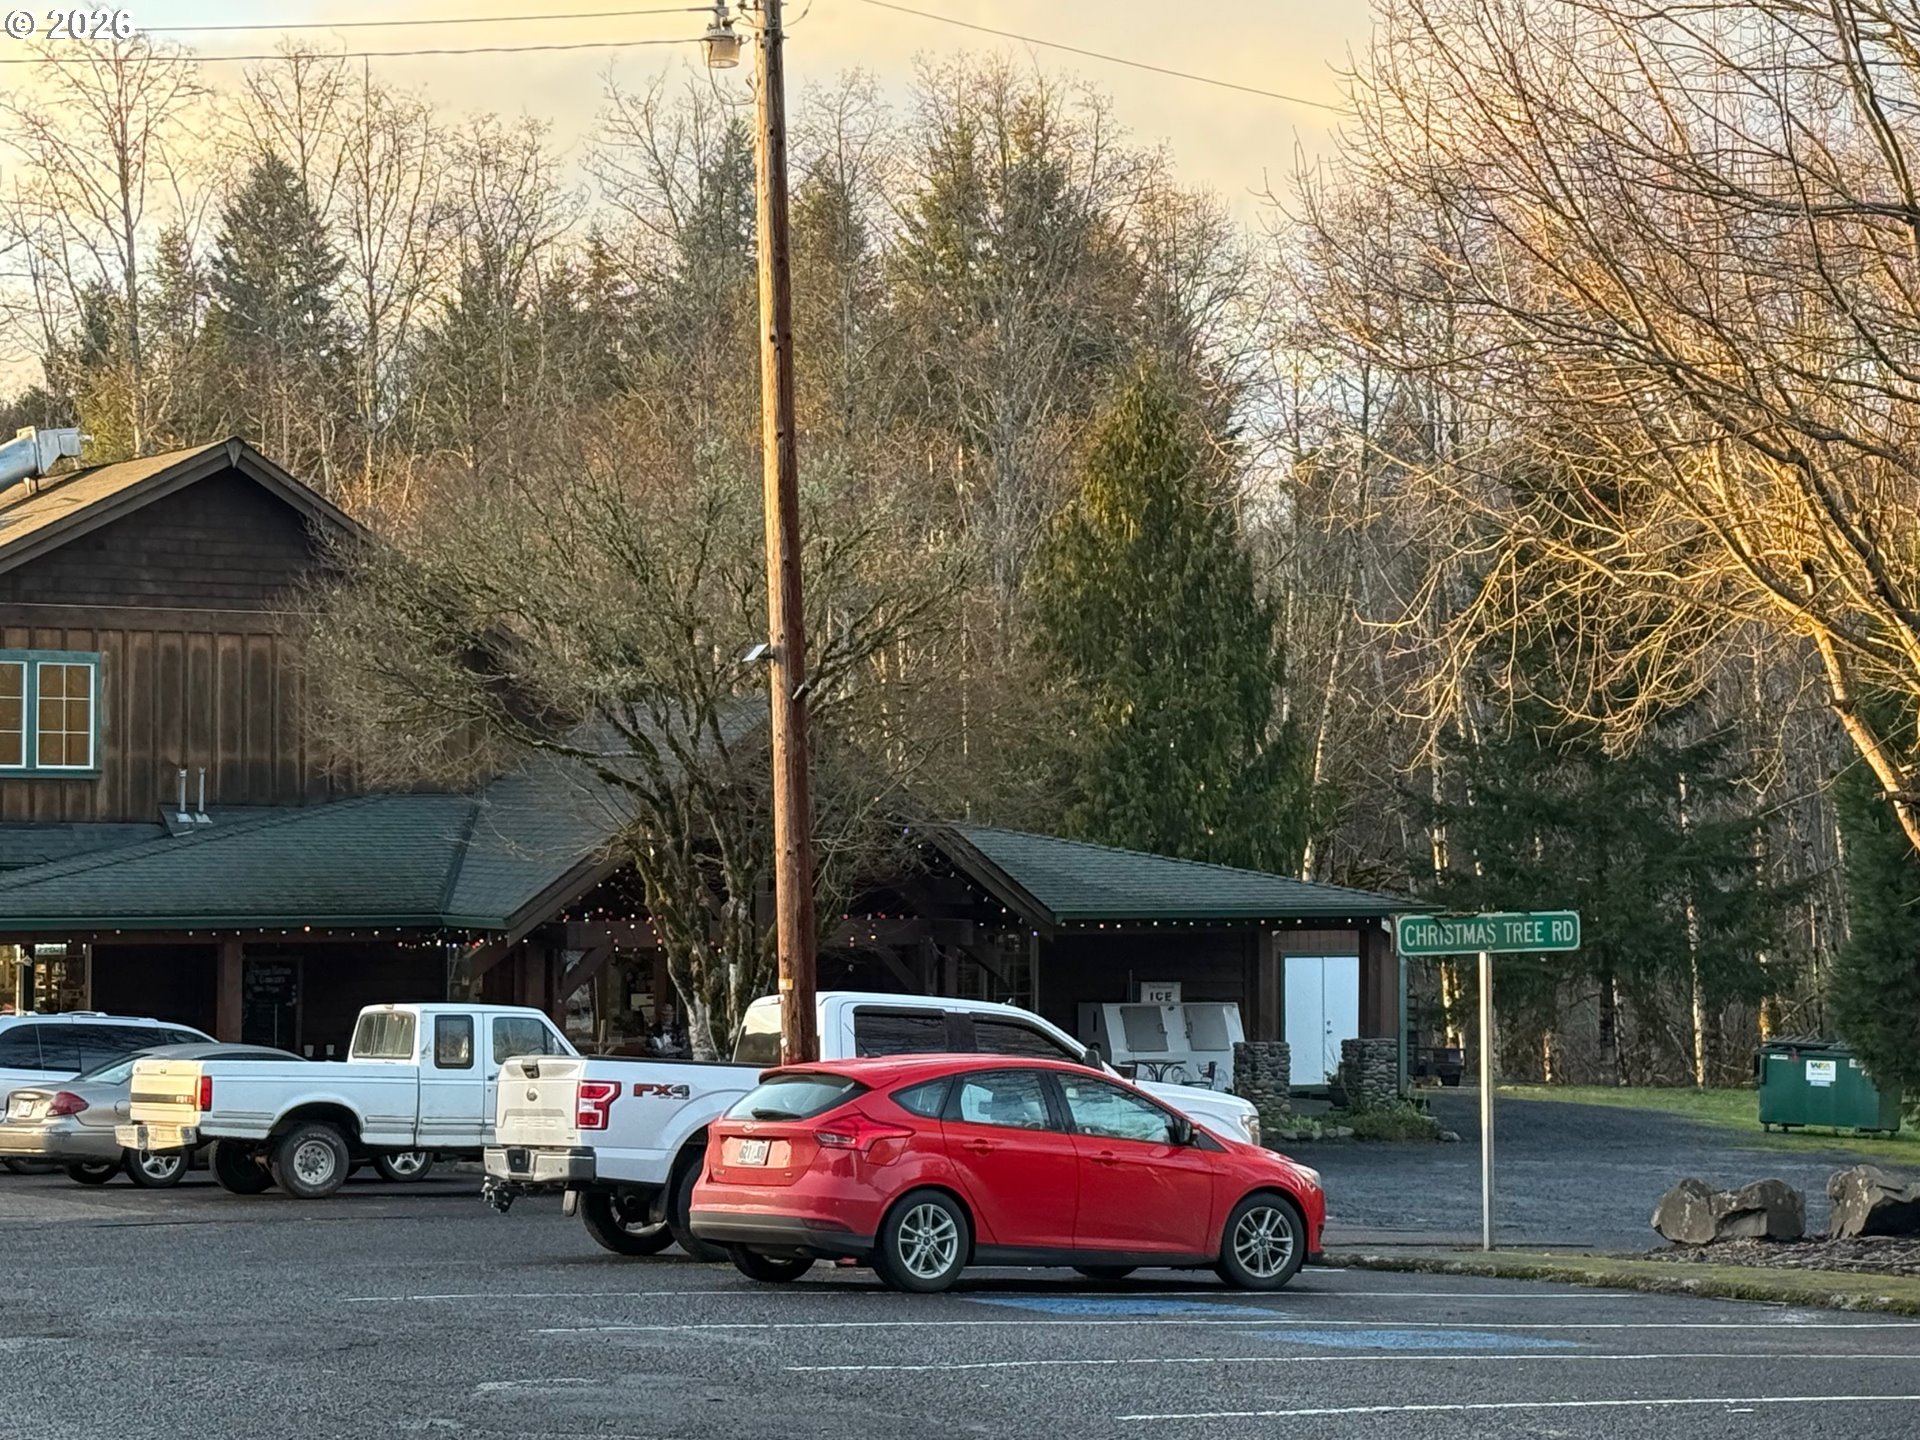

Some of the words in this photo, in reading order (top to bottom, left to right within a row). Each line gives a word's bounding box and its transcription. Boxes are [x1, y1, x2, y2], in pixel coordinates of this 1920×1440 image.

[1404, 922, 1497, 947] CHRISTMAS
[1503, 921, 1544, 943] TREE
[1552, 920, 1574, 942] RD
[1150, 991, 1173, 1001] ICE
[633, 1083, 690, 1097] FX4
